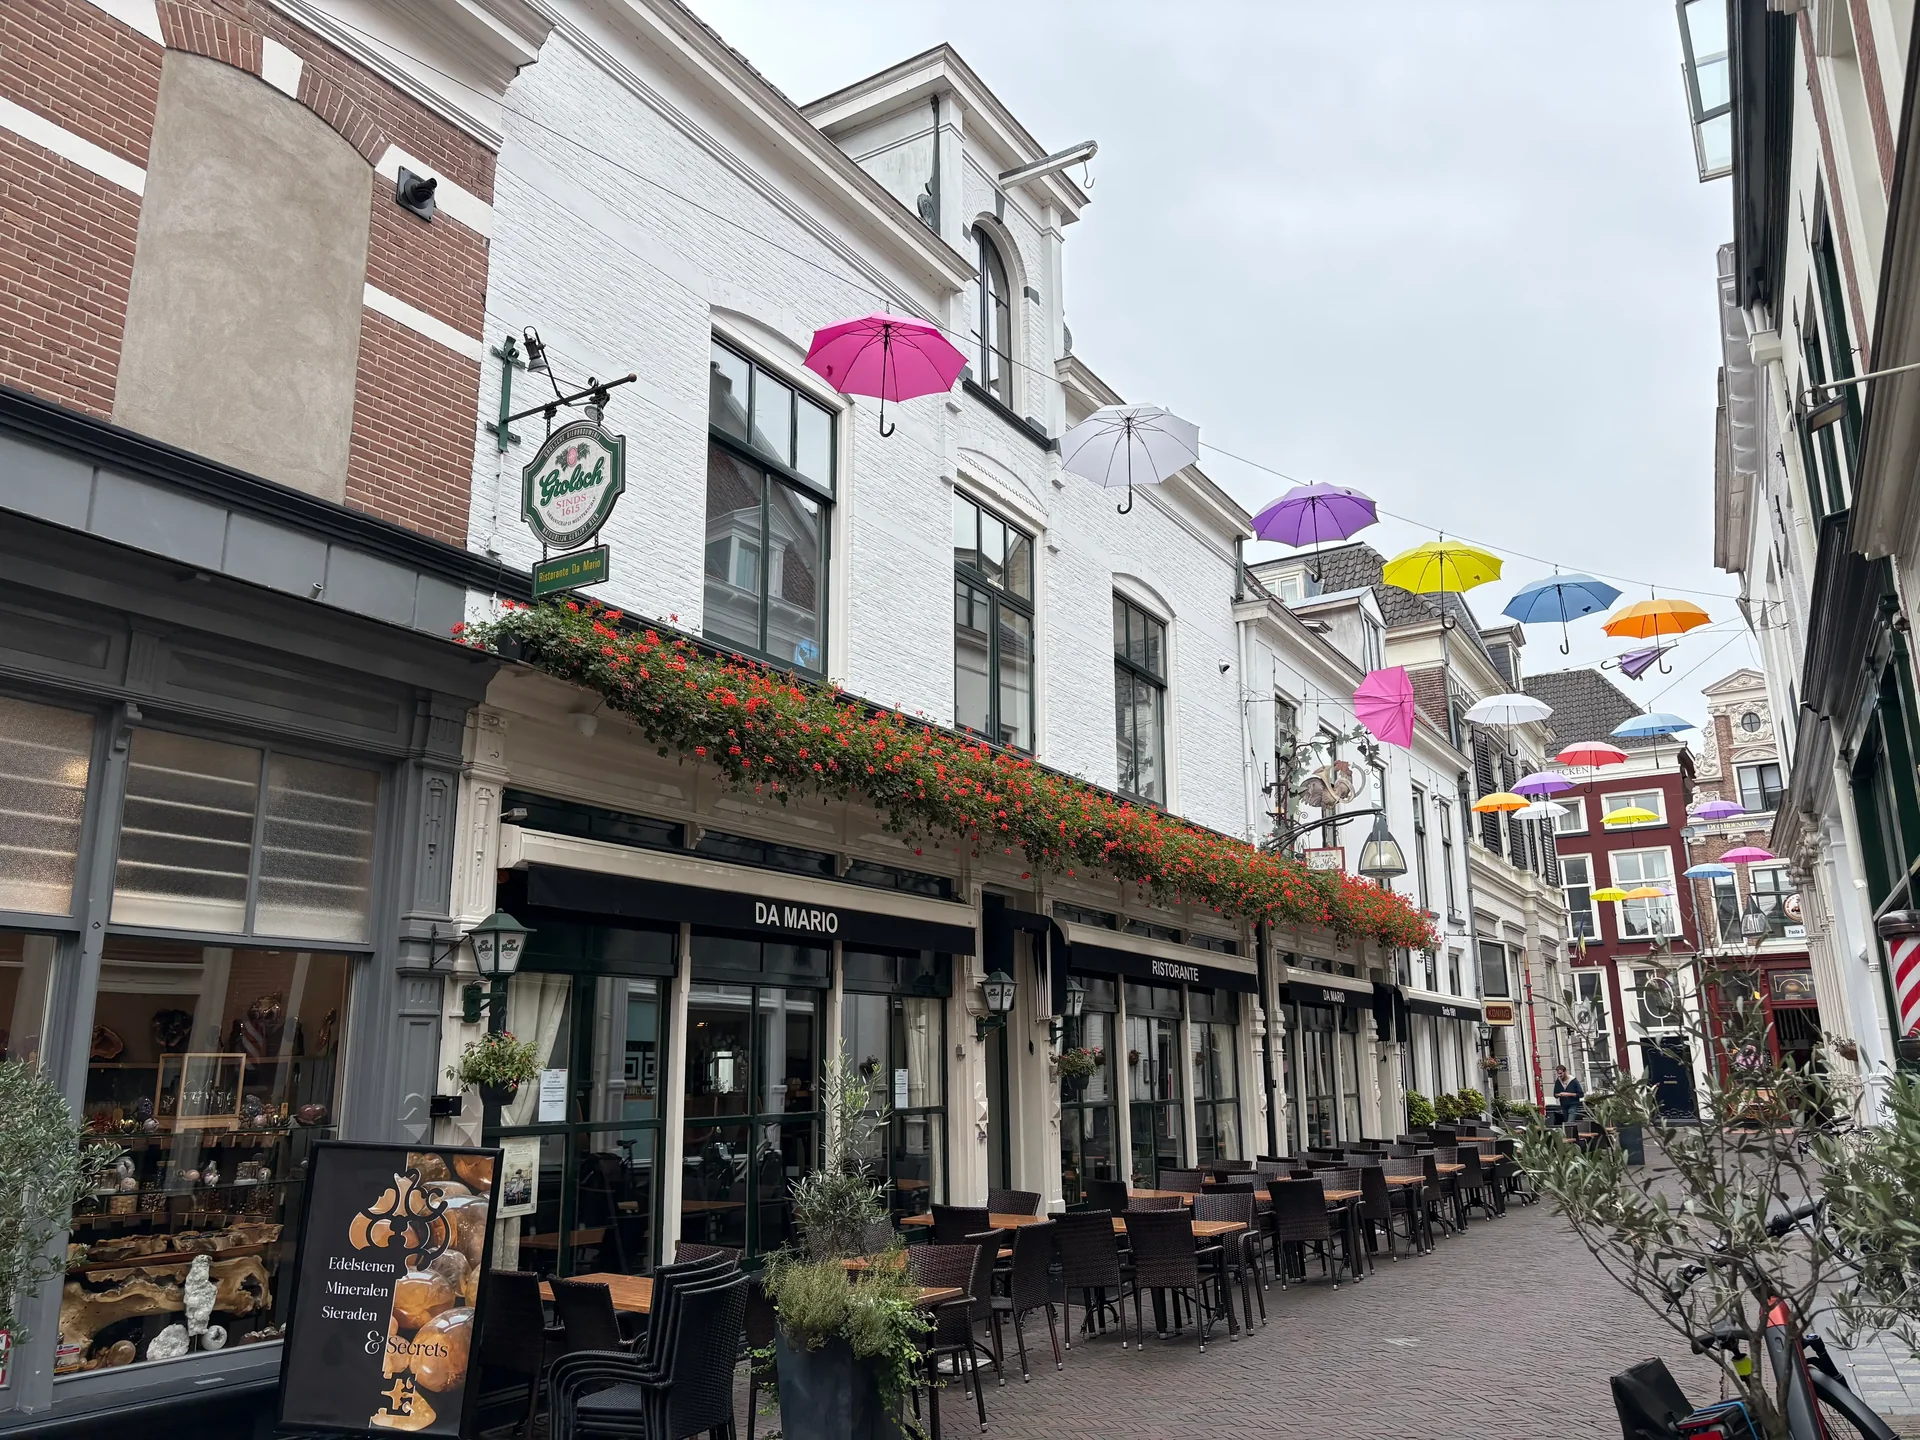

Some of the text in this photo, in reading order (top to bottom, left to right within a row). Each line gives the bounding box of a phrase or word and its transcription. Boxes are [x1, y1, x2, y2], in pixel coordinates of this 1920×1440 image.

[539, 456, 603, 506] Grolsch
[556, 493, 587, 509] SINDS
[562, 504, 581, 516] 1615
[539, 558, 601, 583] Ristorante Da Mario
[1551, 766, 1589, 776] ECKEN
[755, 901, 838, 934] DA MARIO
[1152, 960, 1199, 982] RISTORANTE
[1323, 989, 1345, 1003] DA MARIO
[1487, 1009, 1510, 1018] KONING
[328, 1256, 395, 1273] Edelstenen
[325, 1280, 389, 1297] Mineralen
[321, 1305, 378, 1321] Sieraden
[364, 1330, 449, 1358] & Secrets
